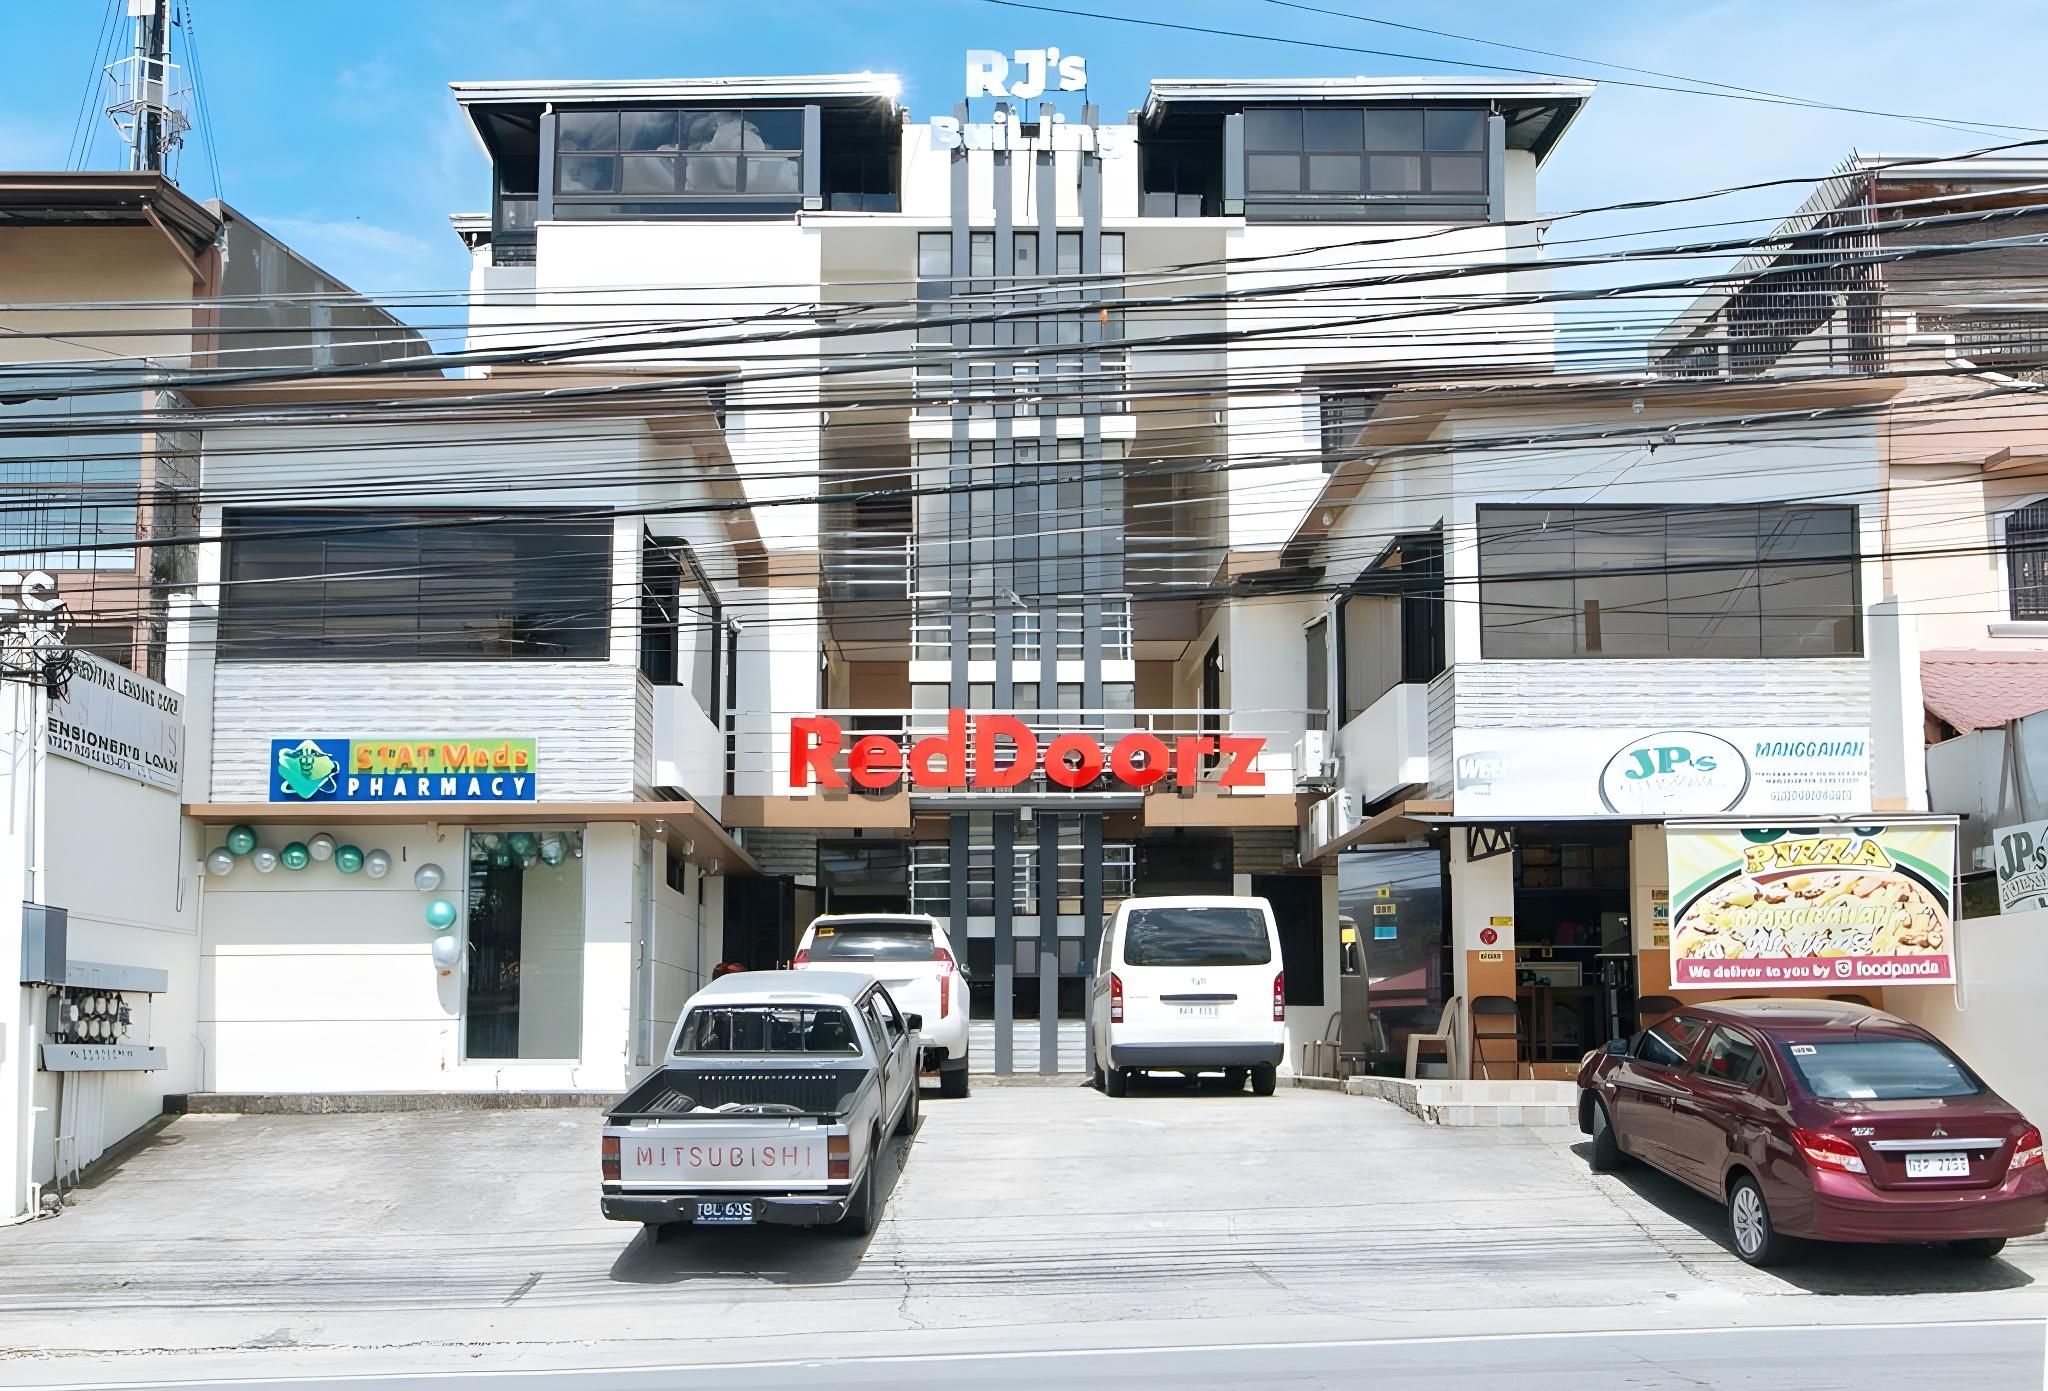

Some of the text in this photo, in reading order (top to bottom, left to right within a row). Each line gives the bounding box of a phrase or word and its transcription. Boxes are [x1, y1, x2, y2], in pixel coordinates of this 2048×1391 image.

[966, 47, 1088, 99] RJ's
[789, 707, 1267, 789] RedDoorz
[347, 777, 526, 797] PHARMACY
[1744, 837, 1892, 874] PIZZA
[1688, 960, 1939, 979] We deliver to you by foodpanda
[636, 1146, 813, 1167] MITSUBISHI
